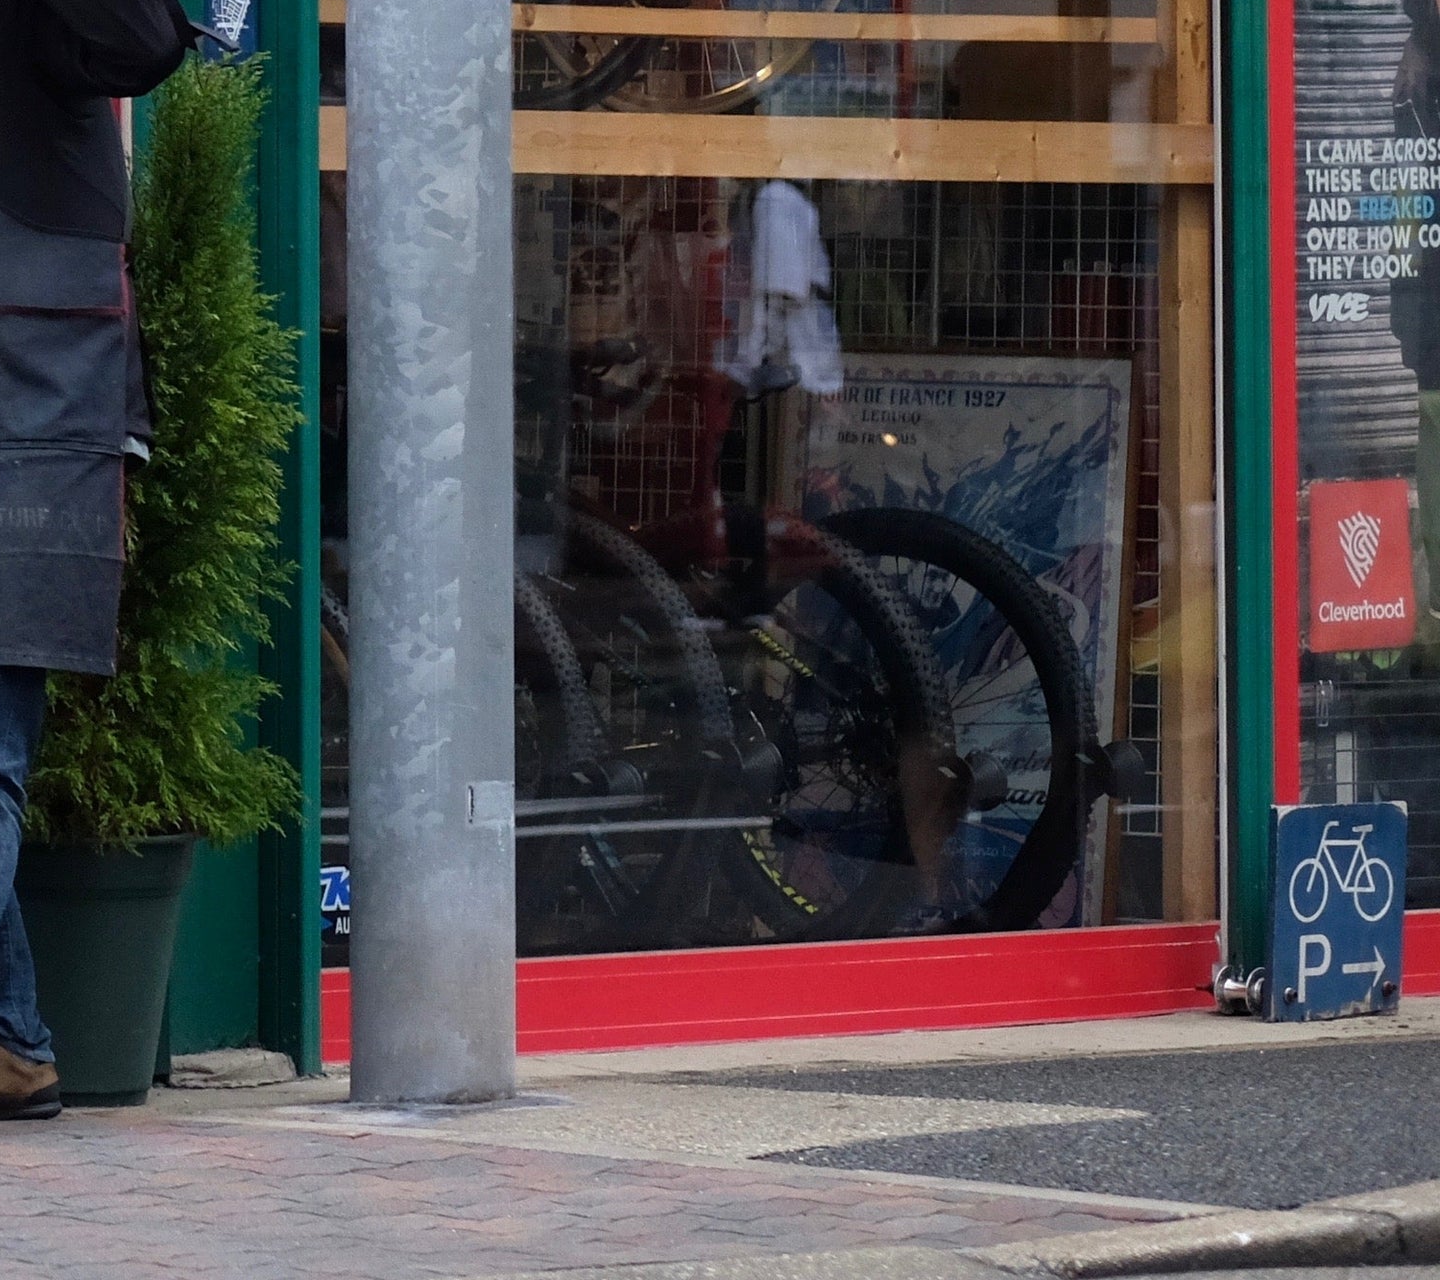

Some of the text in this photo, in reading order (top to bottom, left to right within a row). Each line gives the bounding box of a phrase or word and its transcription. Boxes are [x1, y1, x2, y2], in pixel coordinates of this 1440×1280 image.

[1306, 137, 1440, 163] I CAME ACROS
[1306, 168, 1363, 192] THESE
[1306, 195, 1435, 222] AND FREAKED
[1306, 227, 1359, 252] OVER
[1366, 225, 1412, 251] HOW
[1306, 253, 1419, 281] THEY LOOK.
[1309, 292, 1371, 323] VICE
[965, 389, 1008, 408] 1927
[1318, 597, 1406, 623] Cleverhood
[1297, 933, 1332, 1003] P
